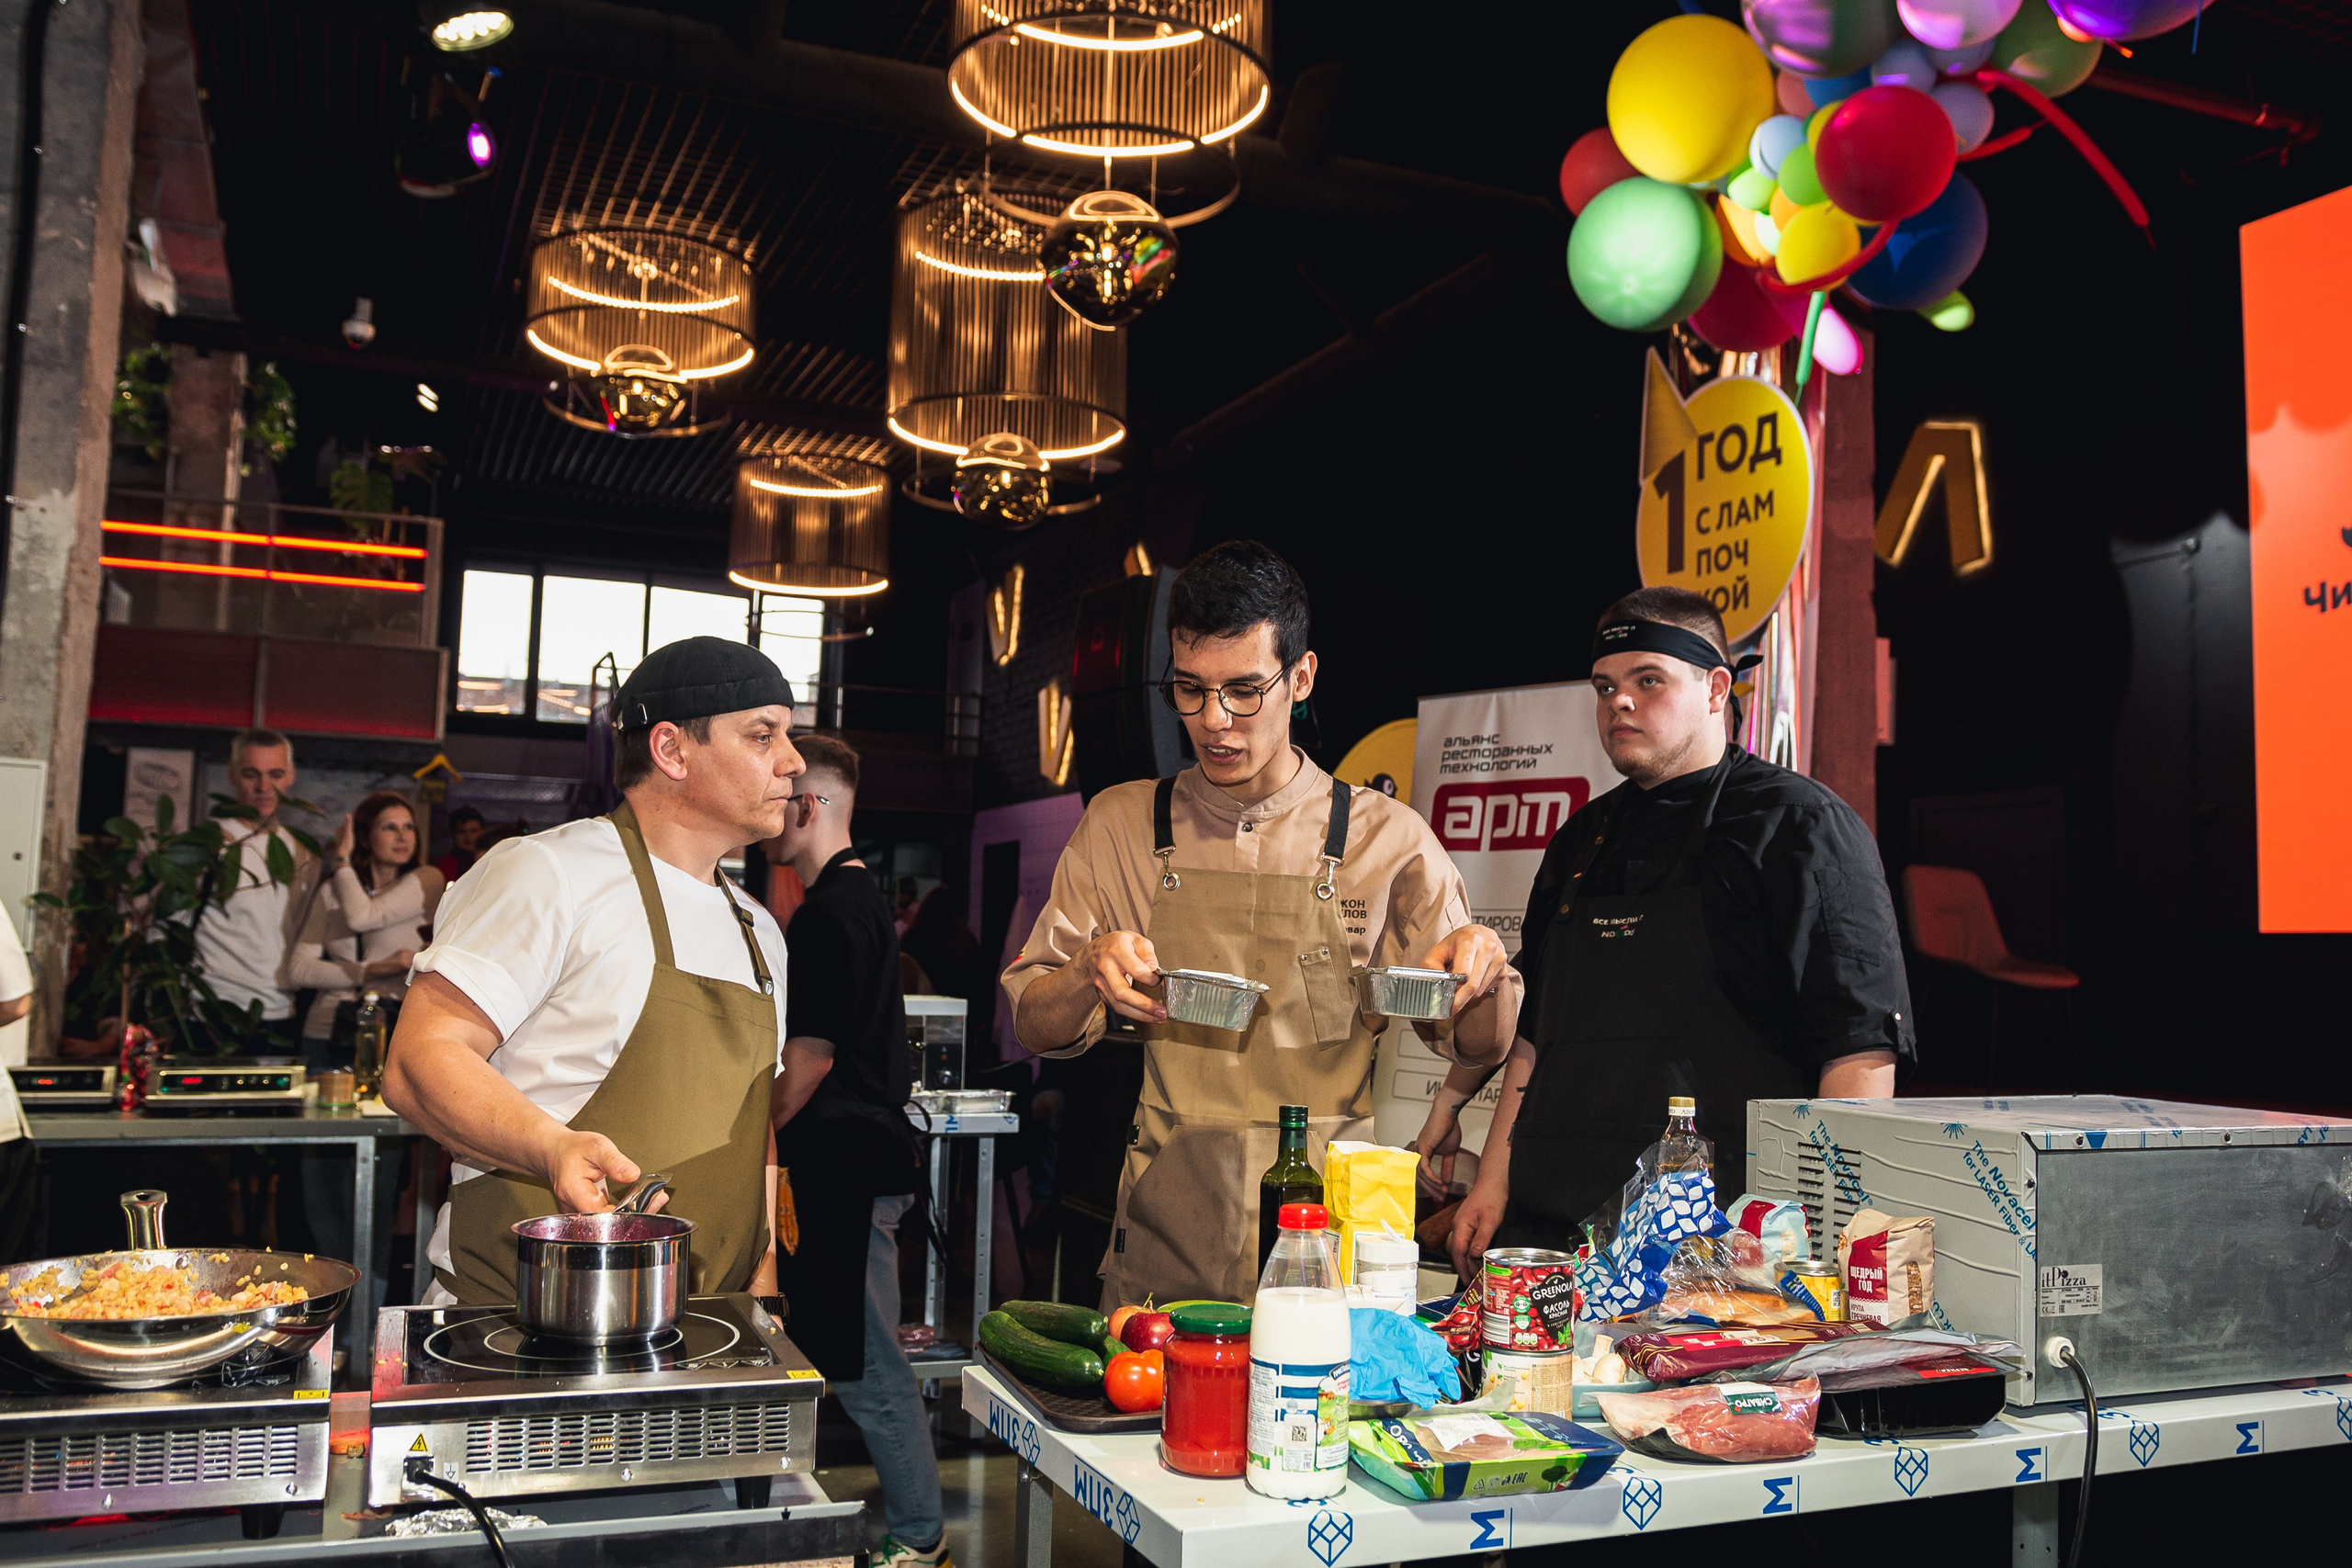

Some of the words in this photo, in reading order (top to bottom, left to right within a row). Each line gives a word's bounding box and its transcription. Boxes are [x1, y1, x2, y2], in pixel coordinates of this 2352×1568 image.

[1653, 449, 1685, 574] 1
[1697, 411, 1782, 480] ГОД
[1696, 538, 1748, 577] ПОЧ
[1443, 734, 1500, 748] альянс
[1441, 743, 1554, 762] ресторанных
[1439, 757, 1538, 774] технологий
[1341, 909, 1367, 919] ЛОВ
[1345, 927, 1366, 935] вар
[1472, 915, 1522, 931] ТИРОВ
[1816, 1119, 1831, 1145] The
[1962, 1151, 1976, 1170] for
[1974, 1168, 2001, 1208] LASER
[1998, 1205, 2020, 1235] Fiber
[1972, 1140, 1989, 1168] The
[1988, 1166, 2037, 1231] Novacel
[1849, 1266, 1883, 1280] ЩЕДРЫЙ
[2041, 1267, 2086, 1287] itPizza
[1532, 1281, 1573, 1300] GREENOLA
[1858, 1280, 1873, 1293] ГОД
[1544, 1300, 1570, 1314] ФАСОЛЬ
[1735, 1397, 1773, 1408] СИВАГРО
